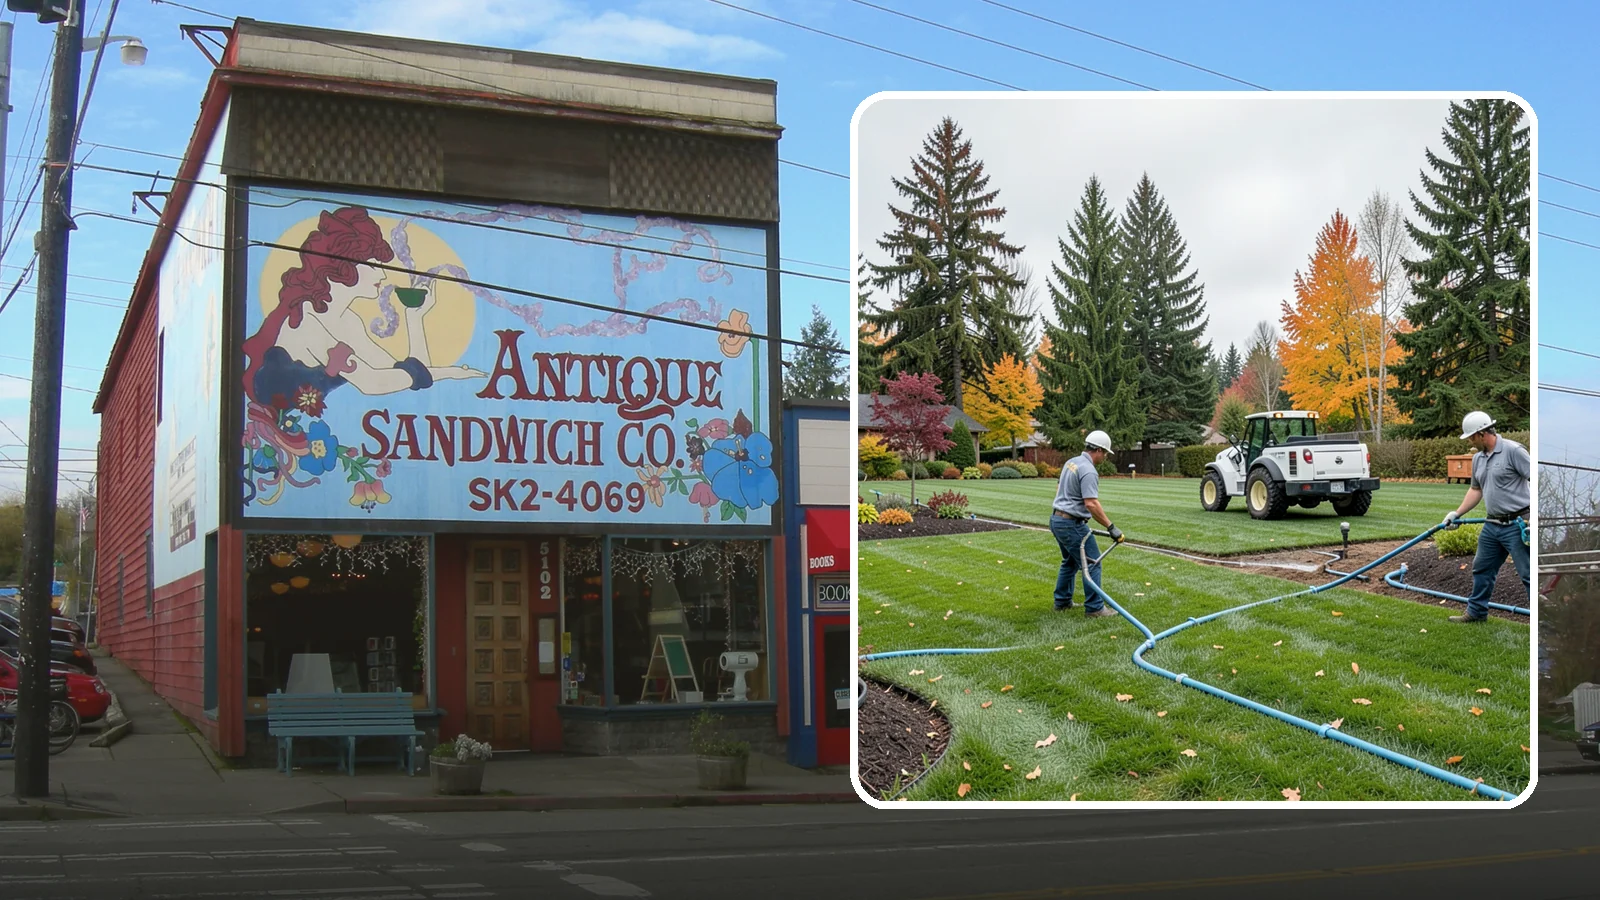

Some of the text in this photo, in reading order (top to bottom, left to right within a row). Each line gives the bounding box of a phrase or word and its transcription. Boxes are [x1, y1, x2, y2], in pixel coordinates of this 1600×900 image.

[475, 328, 724, 420] ANTIQUE
[361, 408, 685, 469] SANDWICH CO.
[468, 476, 646, 512] SK2-4069
[539, 542, 552, 600] 5102
[809, 555, 835, 569] BOOKS
